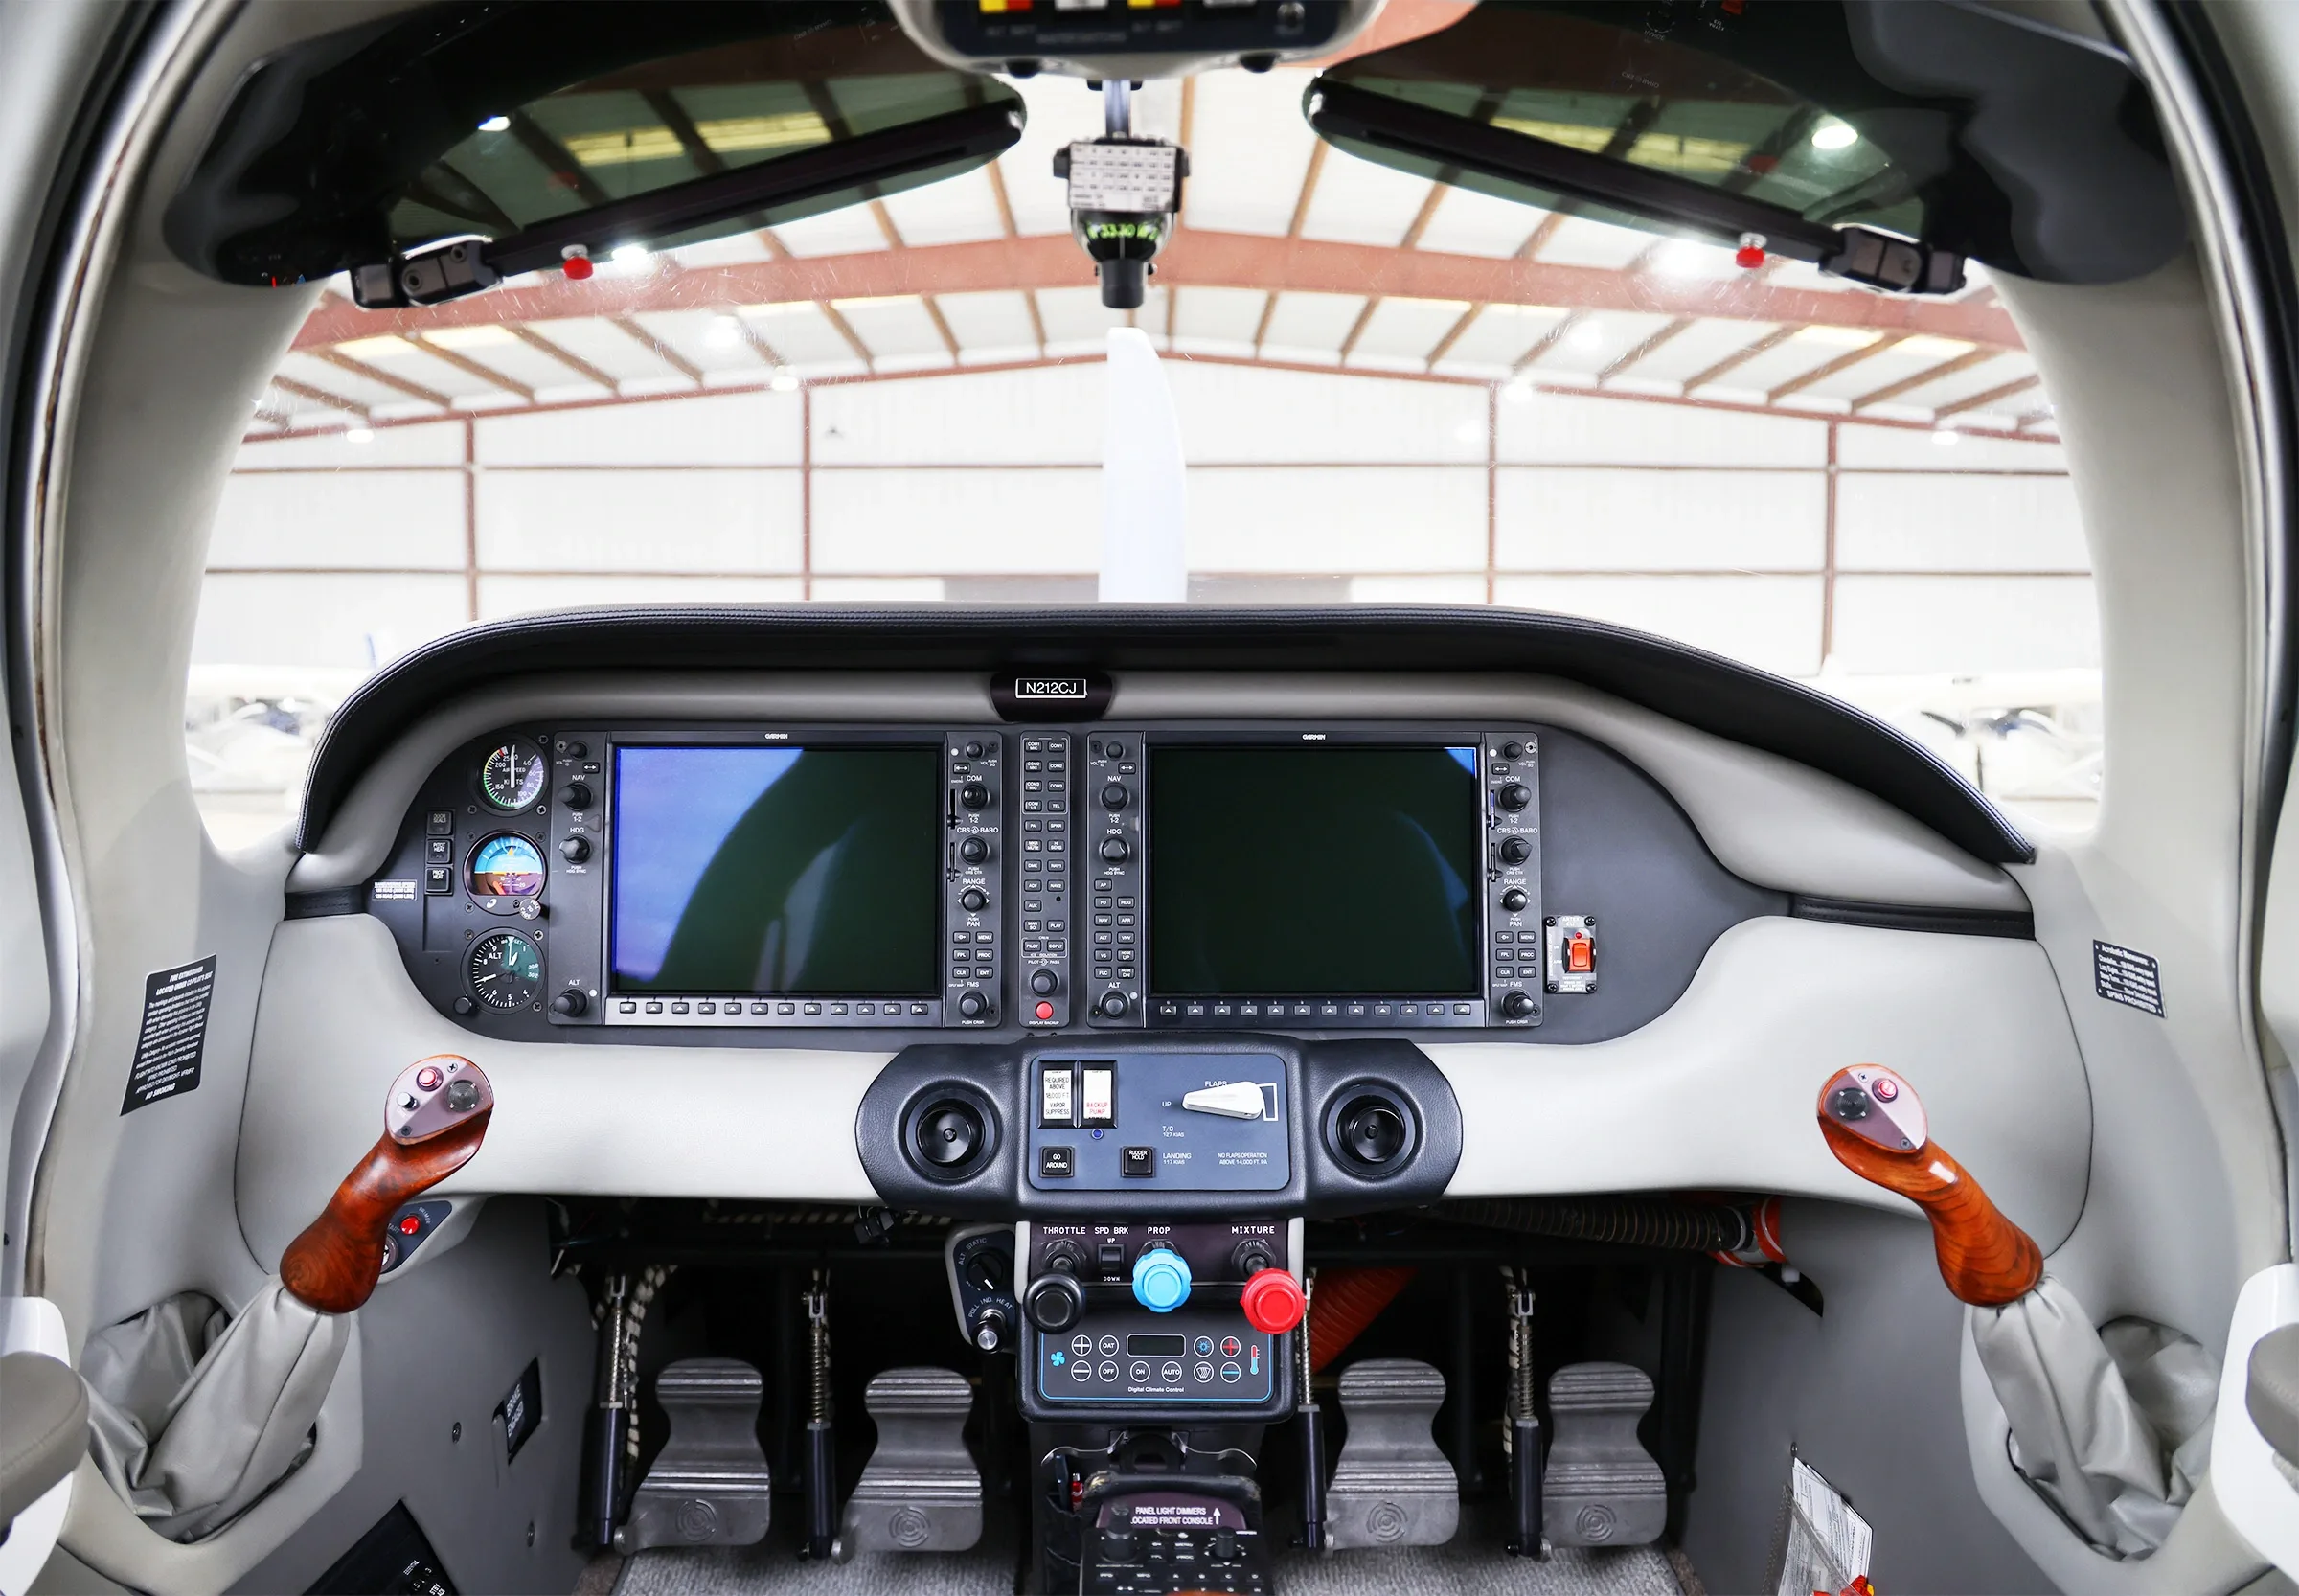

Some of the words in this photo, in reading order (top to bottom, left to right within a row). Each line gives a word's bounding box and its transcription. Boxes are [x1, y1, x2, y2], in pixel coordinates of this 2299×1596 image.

[1026, 682, 1077, 694] N212CJ
[419, 1206, 431, 1224] PRIMER
[1043, 1226, 1086, 1235] THROTTLE
[1094, 1226, 1110, 1235] SPD
[1113, 1226, 1129, 1235] BRK
[1147, 1226, 1171, 1235] PROP
[966, 1237, 988, 1250] STATIC
[968, 1302, 979, 1318] PULL
[995, 1297, 1013, 1311] HEAT
[1130, 1516, 1159, 1525] OCATED
[1159, 1516, 1181, 1525] FRONT
[1182, 1516, 1213, 1525] CONSOLE
